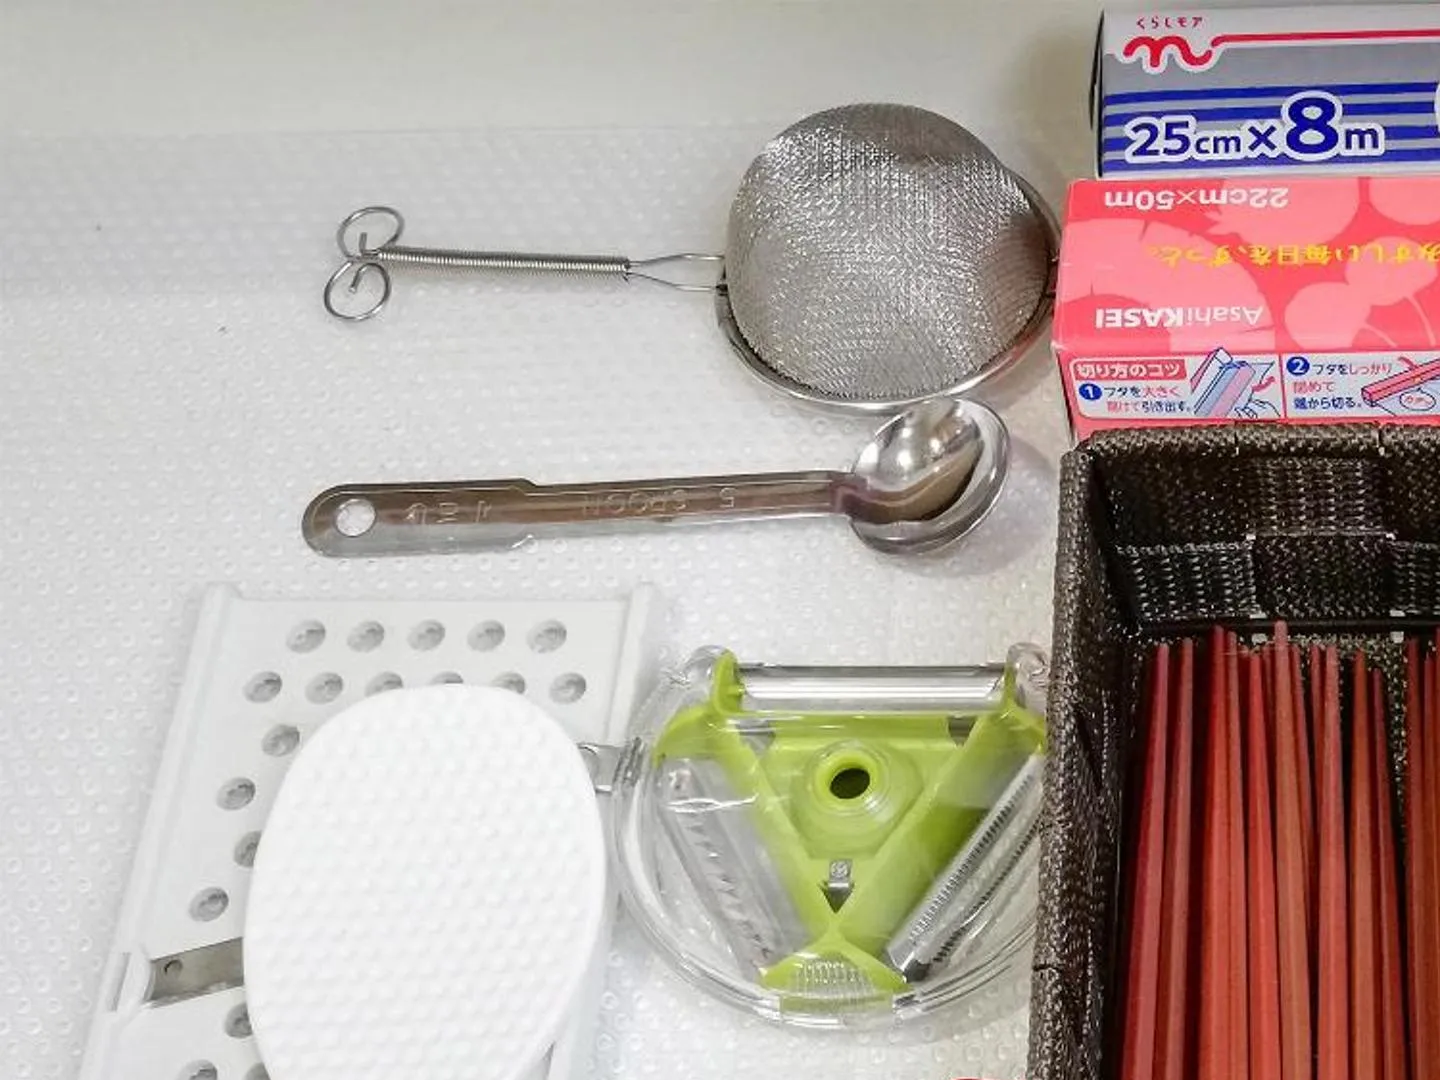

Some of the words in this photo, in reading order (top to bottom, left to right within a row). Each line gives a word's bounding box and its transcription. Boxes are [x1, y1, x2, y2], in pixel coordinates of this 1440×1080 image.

[1136, 15, 1204, 30] くらしモア
[1077, 363, 1181, 379] 切り方のコツ
[1313, 362, 1393, 376] フタをしっかり
